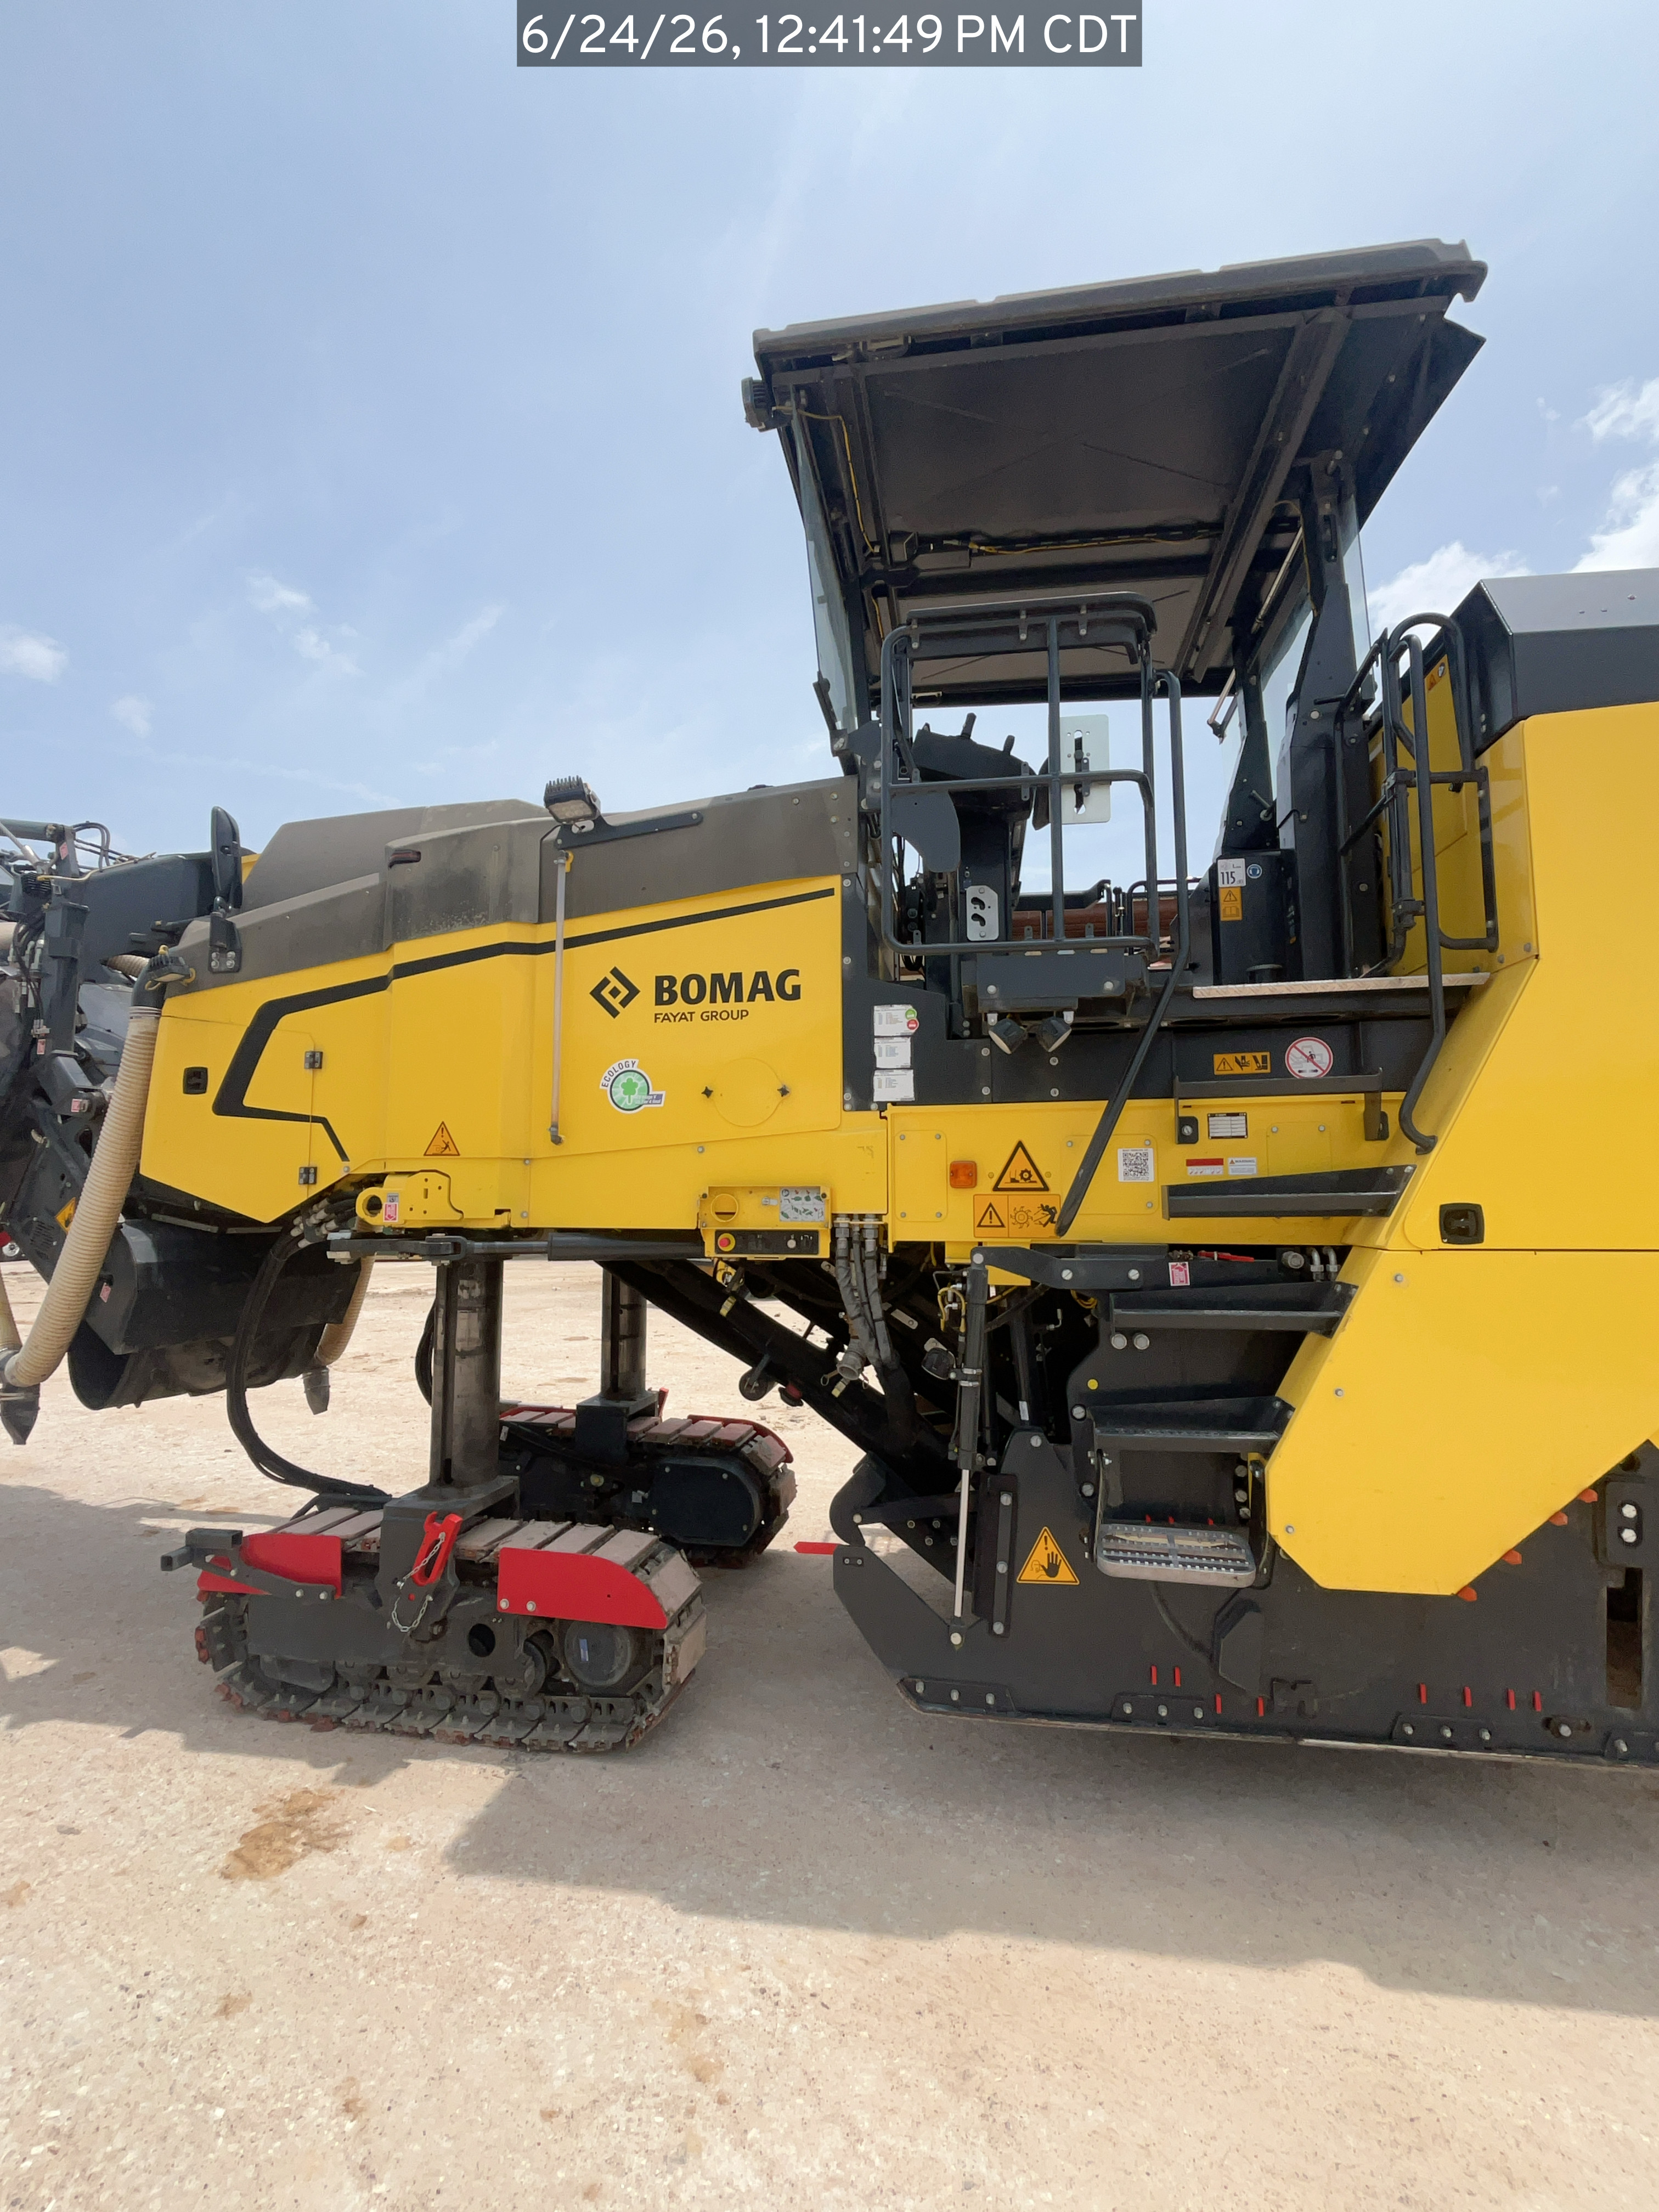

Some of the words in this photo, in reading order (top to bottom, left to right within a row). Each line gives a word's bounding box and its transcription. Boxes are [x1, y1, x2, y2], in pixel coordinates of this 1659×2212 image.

[1220, 871, 1236, 885] 115
[654, 969, 802, 1006] BOMAG
[654, 1011, 696, 1023] FAYAT
[700, 1009, 749, 1022] GROUP
[601, 1060, 636, 1087] ECOLOGY
